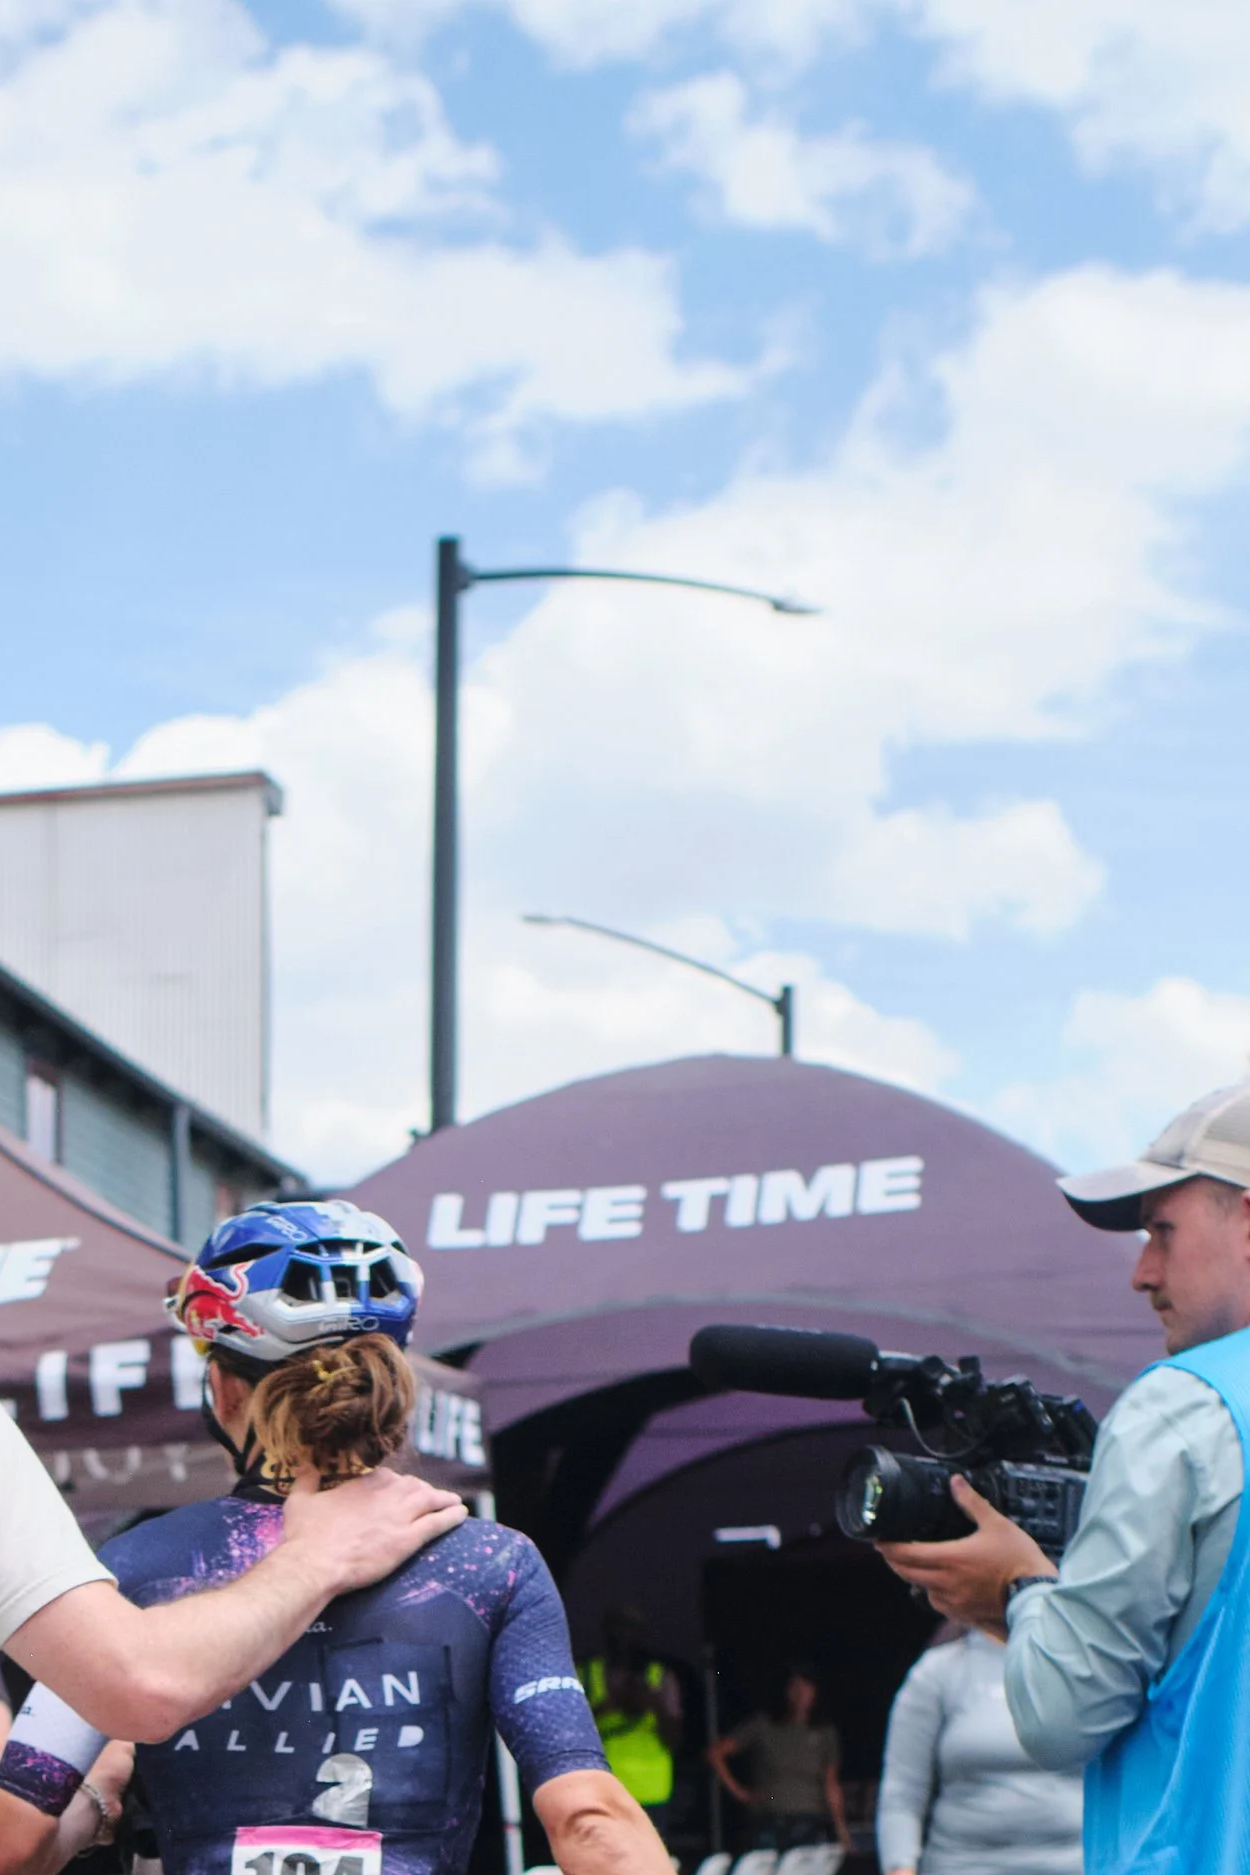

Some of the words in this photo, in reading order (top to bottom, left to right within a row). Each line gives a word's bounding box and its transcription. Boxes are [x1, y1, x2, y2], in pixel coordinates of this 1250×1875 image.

[428, 1185, 647, 1250] LIFE
[662, 1156, 924, 1233] TIME
[318, 1316, 380, 1332] GIRO
[417, 1386, 486, 1466] LIFE
[221, 1671, 421, 1711] VIAN
[513, 1676, 585, 1704] SRA
[174, 1725, 424, 1754] ALLIED
